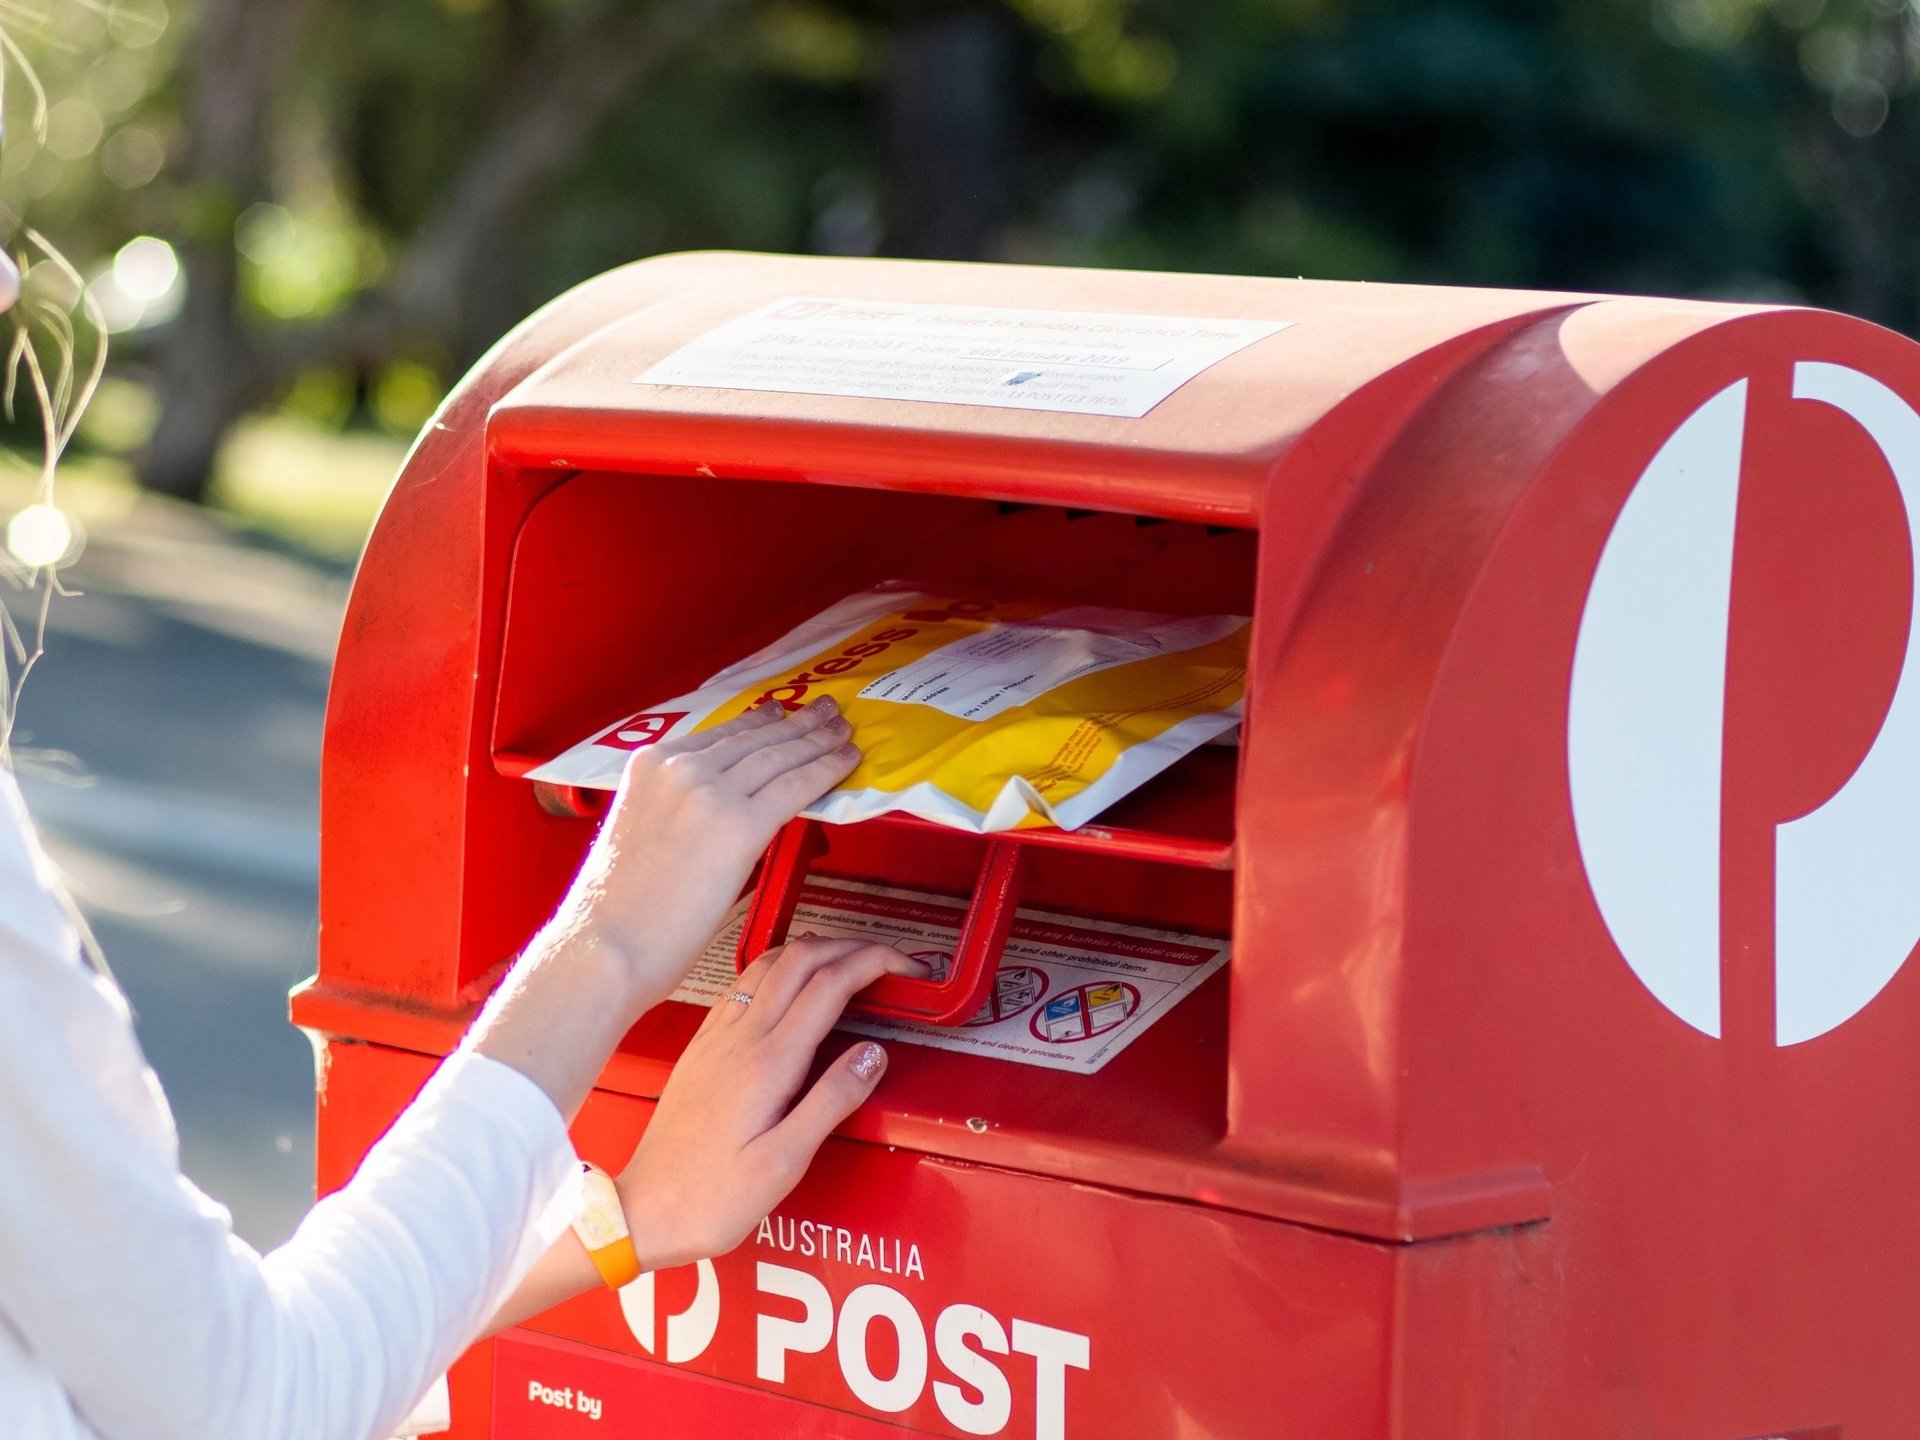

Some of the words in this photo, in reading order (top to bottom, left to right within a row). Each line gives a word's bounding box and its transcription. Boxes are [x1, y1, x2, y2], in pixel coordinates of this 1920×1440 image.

[1011, 321, 1087, 332] Sunday
[1087, 324, 1187, 336] Clearance
[1189, 330, 1241, 338] Time
[808, 337, 909, 350] SUNDAY
[999, 350, 1079, 361] January
[1080, 354, 1130, 363] 2019
[743, 627, 920, 712] press
[901, 684, 924, 701] Mobile
[963, 707, 980, 717] City
[981, 693, 1001, 705] State
[832, 894, 864, 907] goods
[864, 901, 891, 912] must
[921, 911, 959, 922] posted
[1019, 945, 1039, 955] and
[1039, 948, 1067, 961] other
[1066, 953, 1118, 968] prohibited
[1119, 961, 1149, 973] items.
[1044, 930, 1063, 941] any
[1064, 933, 1110, 947] Australia
[1111, 940, 1135, 952] Post
[1136, 944, 1164, 956] retail
[1164, 950, 1199, 962] outlet.
[691, 986, 718, 997] lodged
[915, 1027, 948, 1039] aviation
[948, 1033, 979, 1045] security
[981, 1037, 998, 1047] and
[998, 1041, 1029, 1054] clearing
[1030, 1047, 1075, 1061] procedures
[756, 1215, 925, 1281] AUSTRALIA
[757, 1260, 1091, 1440] POST
[528, 1380, 574, 1410] Post
[577, 1390, 603, 1420] by
